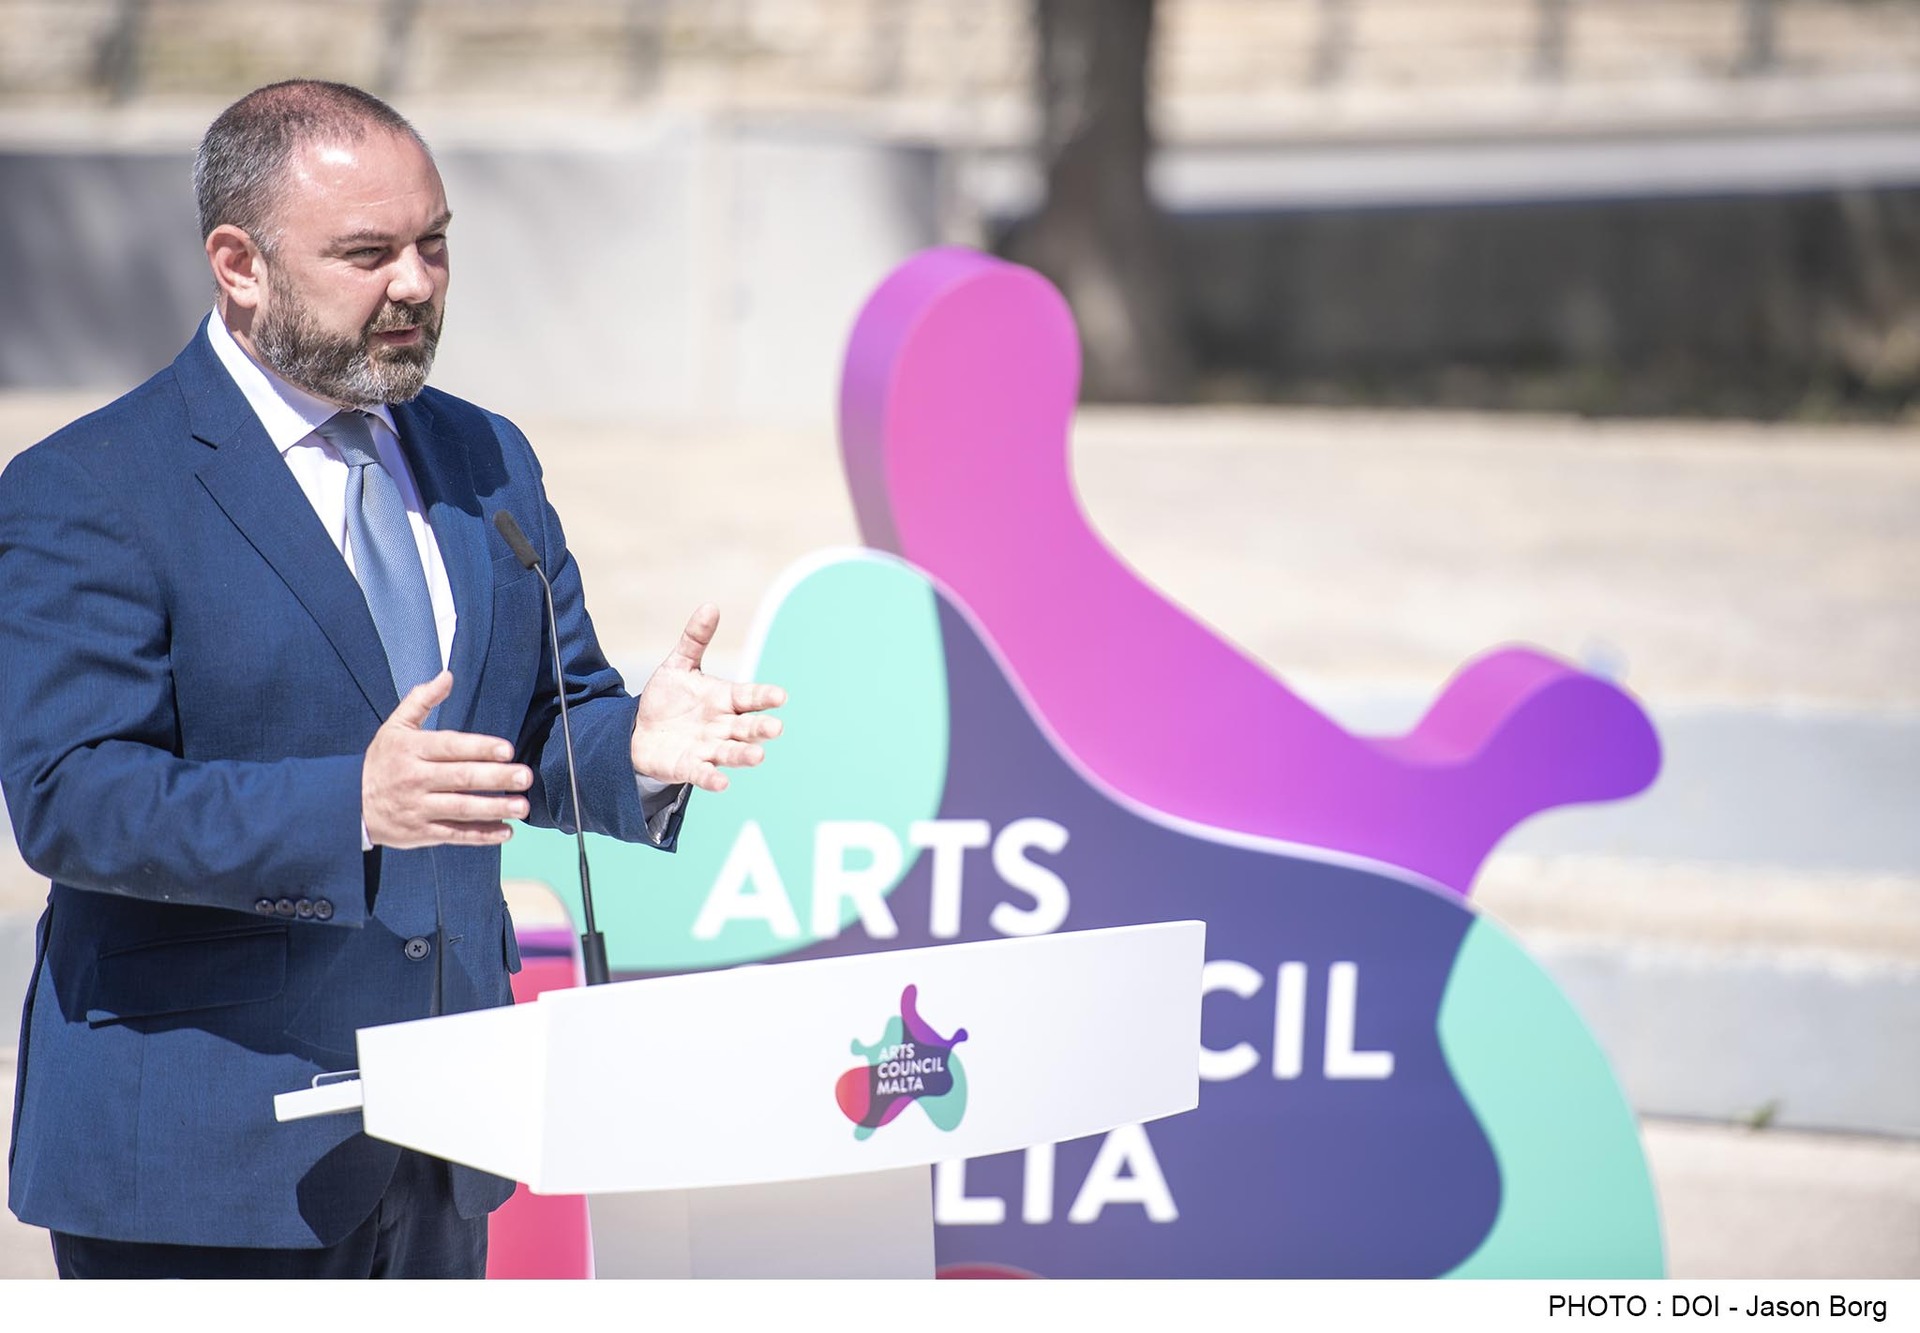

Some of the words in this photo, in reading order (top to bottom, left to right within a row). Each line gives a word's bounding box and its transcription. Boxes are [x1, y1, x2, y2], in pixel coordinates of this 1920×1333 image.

[692, 818, 1071, 940] ARTS
[878, 1043, 916, 1061] ARTS
[877, 1057, 945, 1079] COUNCIL
[876, 1076, 925, 1096] MALTA
